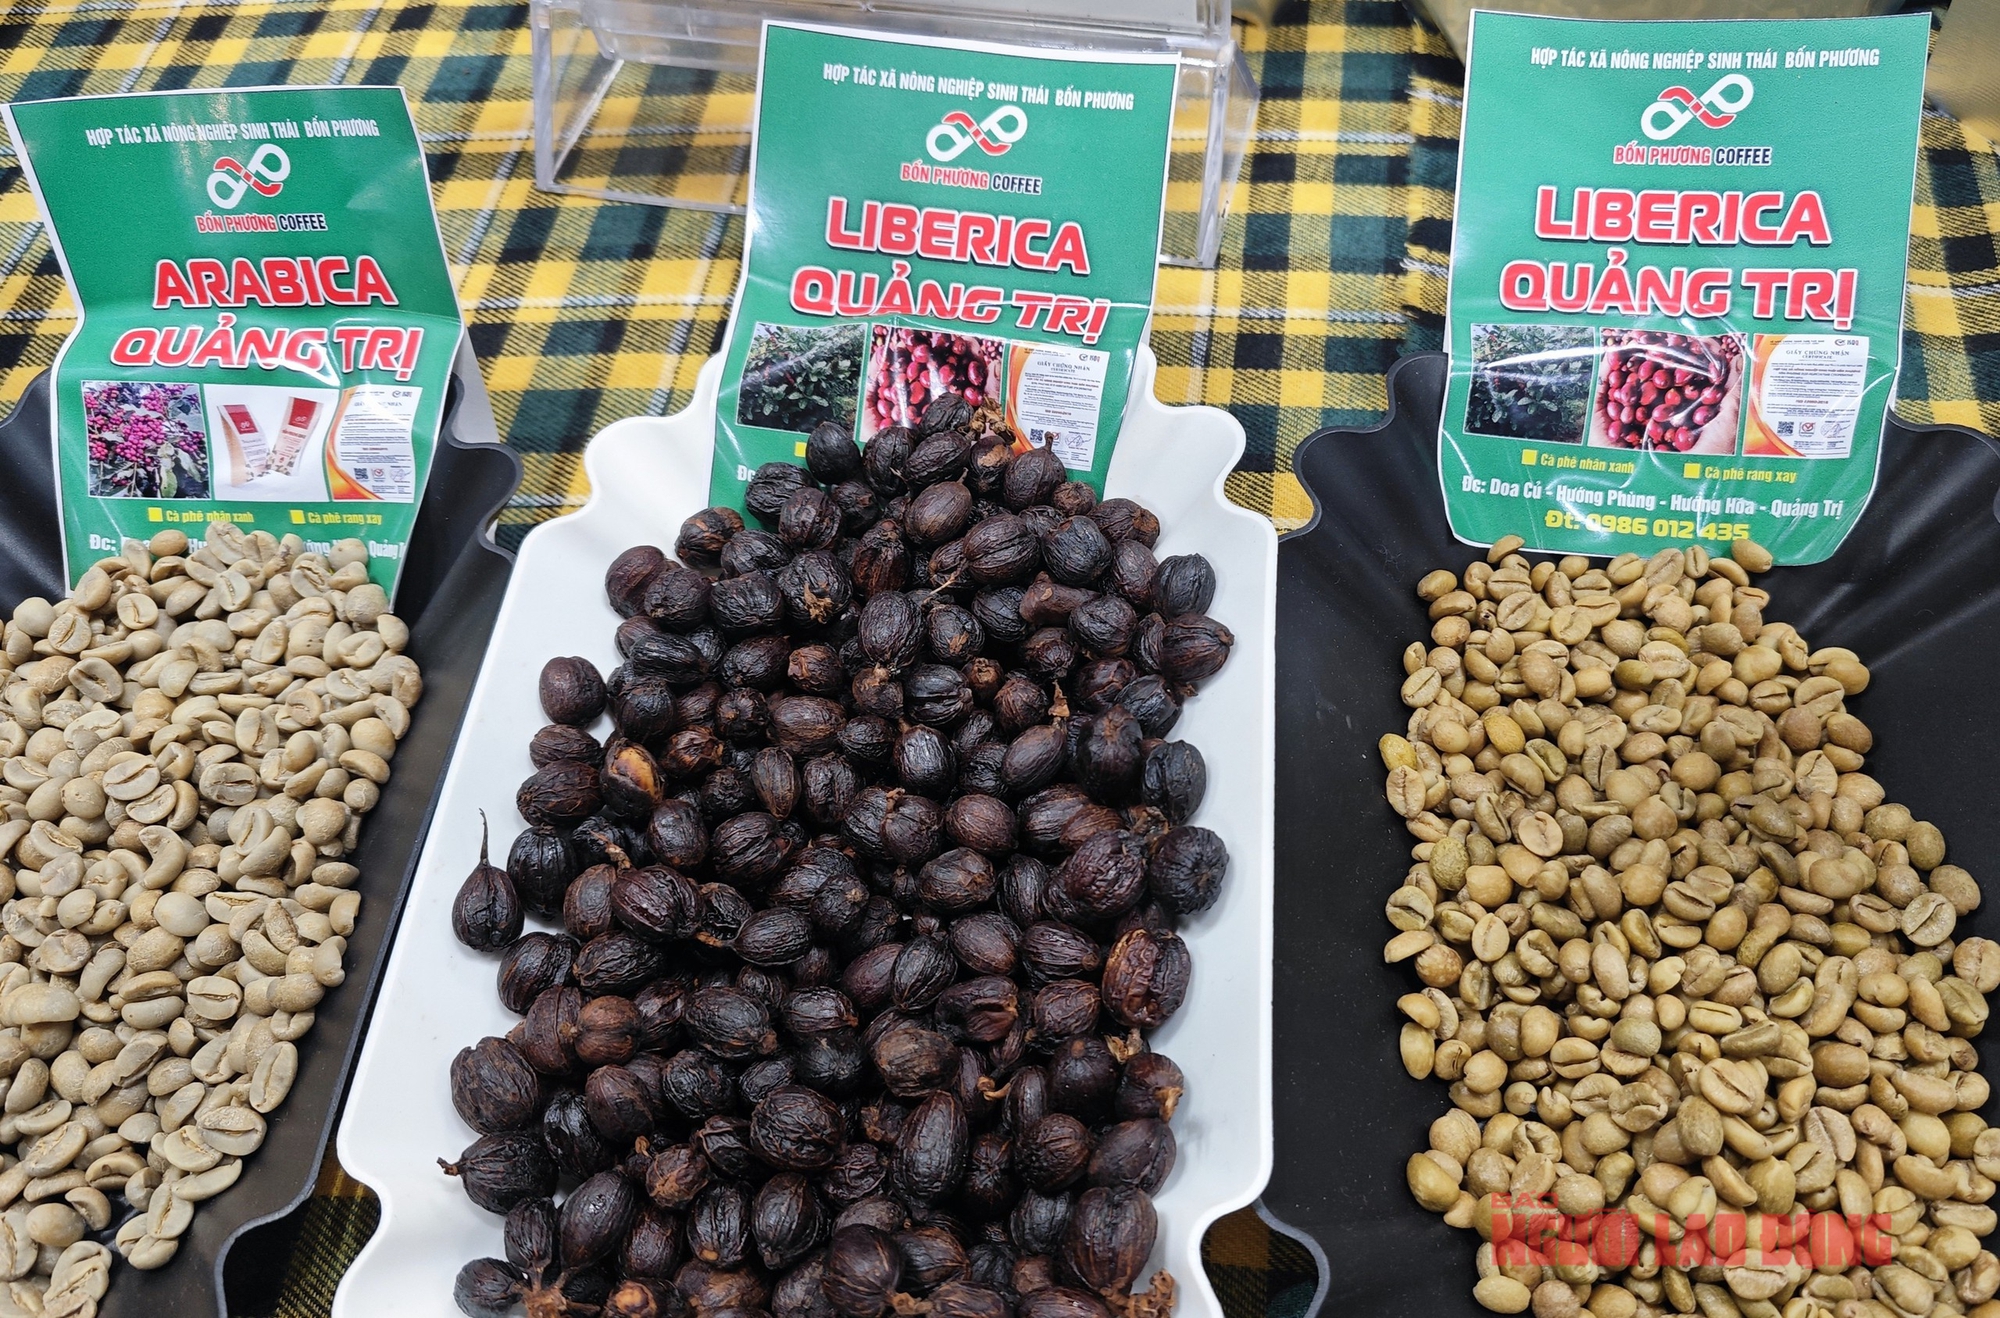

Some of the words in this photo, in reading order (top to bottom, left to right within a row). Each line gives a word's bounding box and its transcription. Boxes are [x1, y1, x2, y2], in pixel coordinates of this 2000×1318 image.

[1530, 47, 1558, 69] HỢP
[1560, 48, 1586, 68] TÁC
[1588, 49, 1608, 69] XÃ
[1610, 49, 1649, 69] NÔNG
[1652, 48, 1705, 73] NGHIỆP
[1707, 52, 1742, 69] SINH
[1745, 50, 1778, 69] THÁI
[1784, 45, 1817, 68] BỐN
[1818, 48, 1880, 68] PHƯƠNG
[823, 63, 850, 85] HỢP
[853, 66, 877, 86] TÁC
[879, 69, 897, 89] XÃ
[899, 71, 935, 93] NÔNG
[937, 75, 984, 101] NGHIỆP
[987, 82, 1018, 102] SINH
[1021, 85, 1049, 105] THÁI
[1054, 84, 1082, 107] BỐN
[1083, 92, 1134, 111] PHƯƠNG
[85, 127, 113, 148] HỢP
[115, 124, 142, 144] TÁC
[142, 123, 162, 143] XÃ
[162, 122, 196, 142] NÔNG
[196, 121, 238, 144] NGHIỆP
[241, 121, 270, 140] SINH
[270, 118, 300, 139] THÁI
[303, 115, 332, 138] BỐN
[332, 119, 380, 137] PHƯƠNG
[1613, 140, 1647, 165] BỐN
[1648, 145, 1712, 165] PHƯƠNG
[1713, 145, 1772, 165] COFFEE
[900, 158, 931, 184] BỐN
[932, 166, 989, 190] PHƯƠNG
[991, 174, 1043, 195] COFFEE
[195, 210, 225, 233] BỐN
[225, 214, 278, 233] PHƯƠNG
[278, 213, 328, 231] COFFEE
[1535, 185, 1832, 246] LIBERICA
[825, 196, 1091, 276] LIBERICA
[153, 255, 400, 308] ARABICA
[1500, 247, 1732, 318] QUẢNG
[1741, 267, 1858, 331] TRỊ
[790, 260, 1005, 323] QUẢNG
[1011, 290, 1111, 343] TRỊ
[110, 312, 328, 370] QUẢNG
[332, 327, 424, 381] TRỊ
[1540, 453, 1555, 466] Cà
[1557, 456, 1577, 469] phê
[1579, 457, 1606, 472] nhân
[1608, 461, 1635, 474] xanh
[1704, 466, 1720, 479] Cà
[1723, 468, 1743, 482] phê
[1746, 470, 1772, 483] rang
[1774, 471, 1797, 484] xay
[1490, 478, 1519, 497] Doa
[1523, 480, 1542, 499] Củ
[1556, 484, 1603, 506] Hướng
[1607, 489, 1656, 511] Phùng
[1771, 499, 1818, 519] Quảng
[1823, 499, 1843, 520] Trị
[166, 510, 180, 522] Cà
[182, 510, 204, 523] phê
[233, 511, 254, 523] xanh
[307, 511, 321, 524] Cà
[323, 512, 341, 525] phê
[343, 513, 365, 525] rang
[366, 514, 382, 526] xay
[1544, 510, 1580, 530] Đt:
[1587, 513, 1648, 536] 0986
[1652, 519, 1694, 539] 012
[1699, 523, 1749, 541] 435
[89, 533, 117, 551] Đc:
